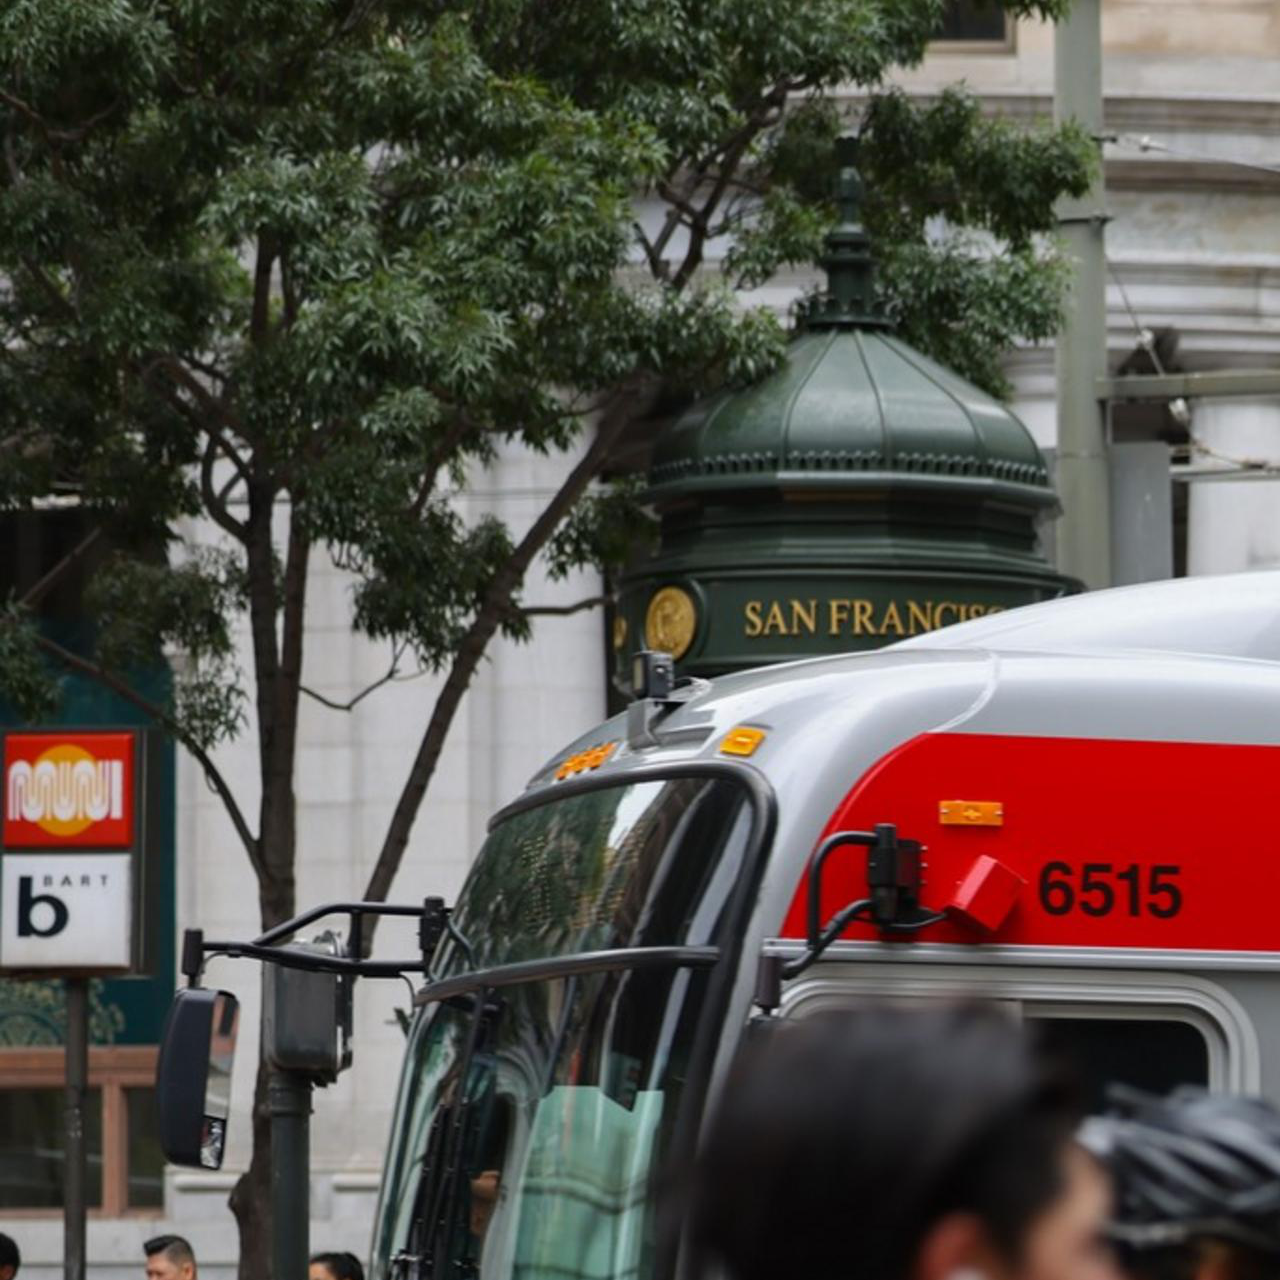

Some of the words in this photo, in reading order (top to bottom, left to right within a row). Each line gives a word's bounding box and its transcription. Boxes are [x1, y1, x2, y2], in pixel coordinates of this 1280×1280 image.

[743, 600, 818, 636] SAN
[828, 600, 1007, 636] FRANCI
[43, 874, 109, 888] BART
[1038, 860, 1183, 919] 6515
[17, 875, 69, 938] b
